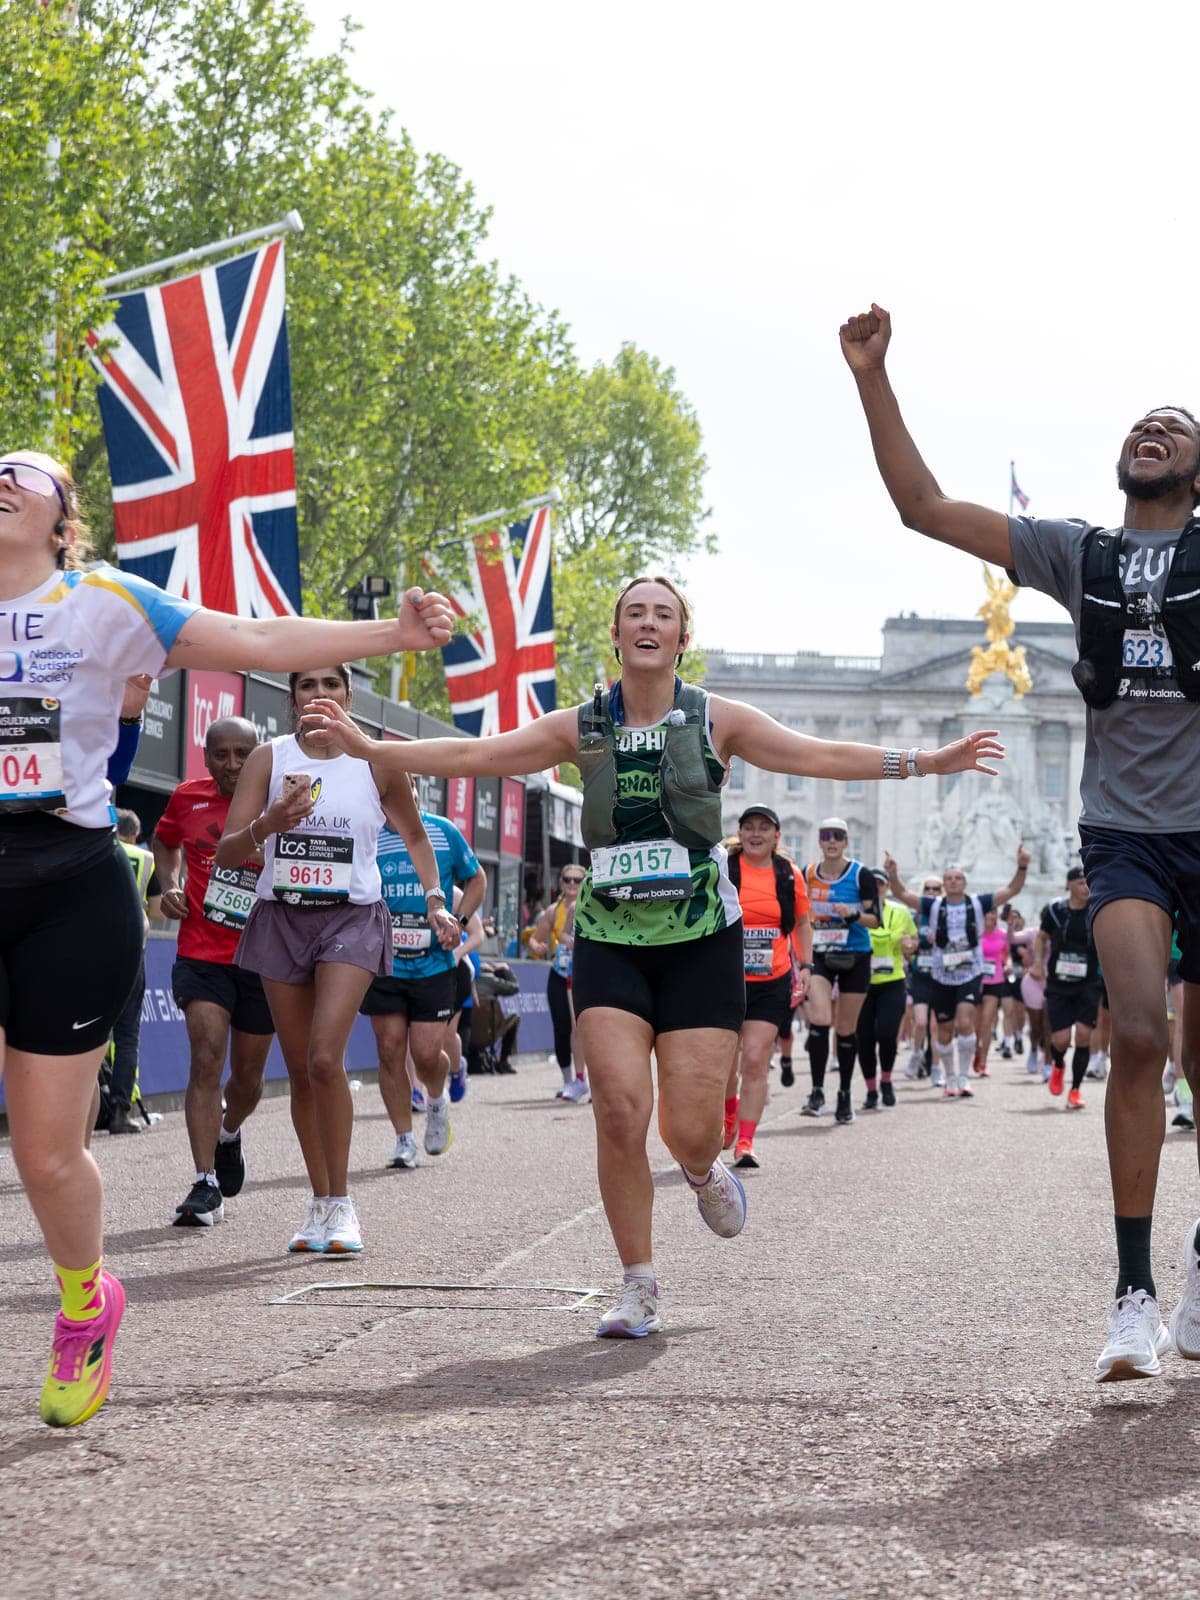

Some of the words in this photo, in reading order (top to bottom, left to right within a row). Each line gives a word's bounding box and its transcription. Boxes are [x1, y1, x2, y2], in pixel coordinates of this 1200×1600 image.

[29, 648, 84, 660] National
[29, 660, 79, 671] Autistic
[29, 671, 74, 683] Society
[1129, 688, 1148, 698] new
[3, 754, 42, 787] 04
[333, 816, 352, 830] UK
[280, 836, 306, 856] tcs
[310, 838, 327, 846] TATA
[308, 845, 349, 854] CONSULTANCY
[308, 851, 335, 859] SERVICES
[609, 847, 672, 877] 79157
[215, 866, 240, 884] tcs
[289, 865, 333, 887] 9613
[215, 886, 253, 913] 7569
[633, 891, 650, 901] new
[650, 888, 685, 898] balance
